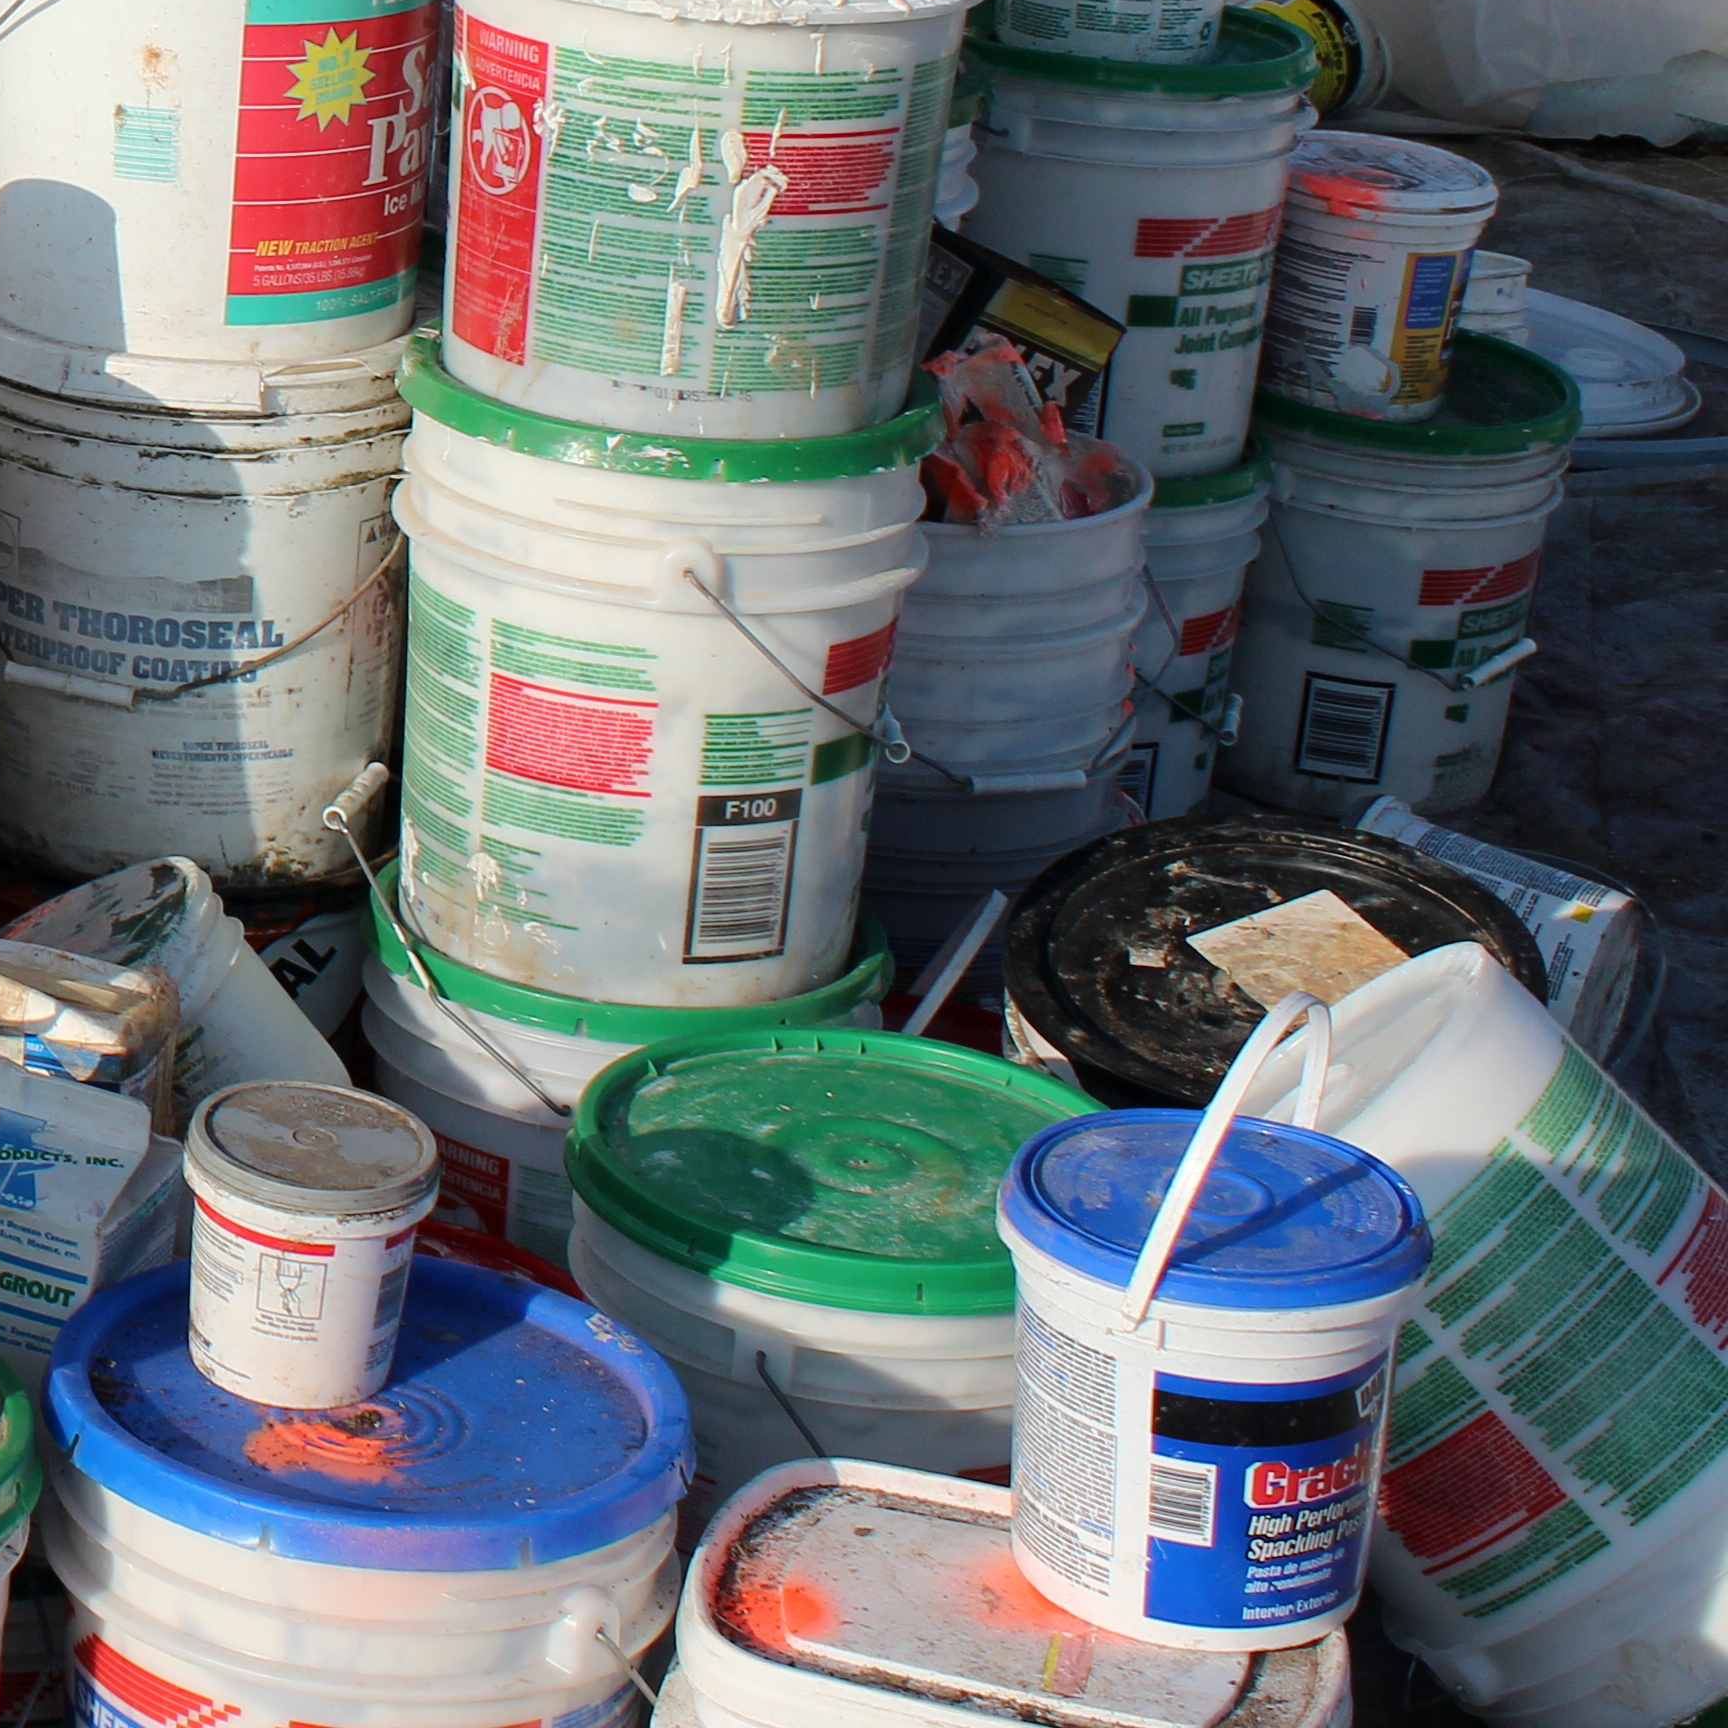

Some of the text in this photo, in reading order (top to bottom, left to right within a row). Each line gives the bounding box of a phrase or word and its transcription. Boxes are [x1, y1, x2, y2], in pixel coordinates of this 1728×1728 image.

[479, 28, 540, 64] WARNING
[475, 57, 542, 92] ADVERTENCIA
[384, 191, 407, 216] Ice
[255, 232, 379, 257] NEW TRACTION AGENT
[317, 270, 331, 284] LBS
[1178, 306, 1200, 327] All
[1175, 334, 1216, 354] Joint
[53, 600, 284, 650] THOROSEAL
[132, 658, 258, 684] COATING
[182, 741, 270, 751] SUPER THOROSEAL
[725, 798, 777, 819] F100
[85, 1156, 125, 1168] INC.
[1248, 1515, 1292, 1538] High
[1247, 1528, 1334, 1562] Spackling
[1247, 1552, 1333, 1580] Pasta masilla
[1244, 1580, 1268, 1594] alto
